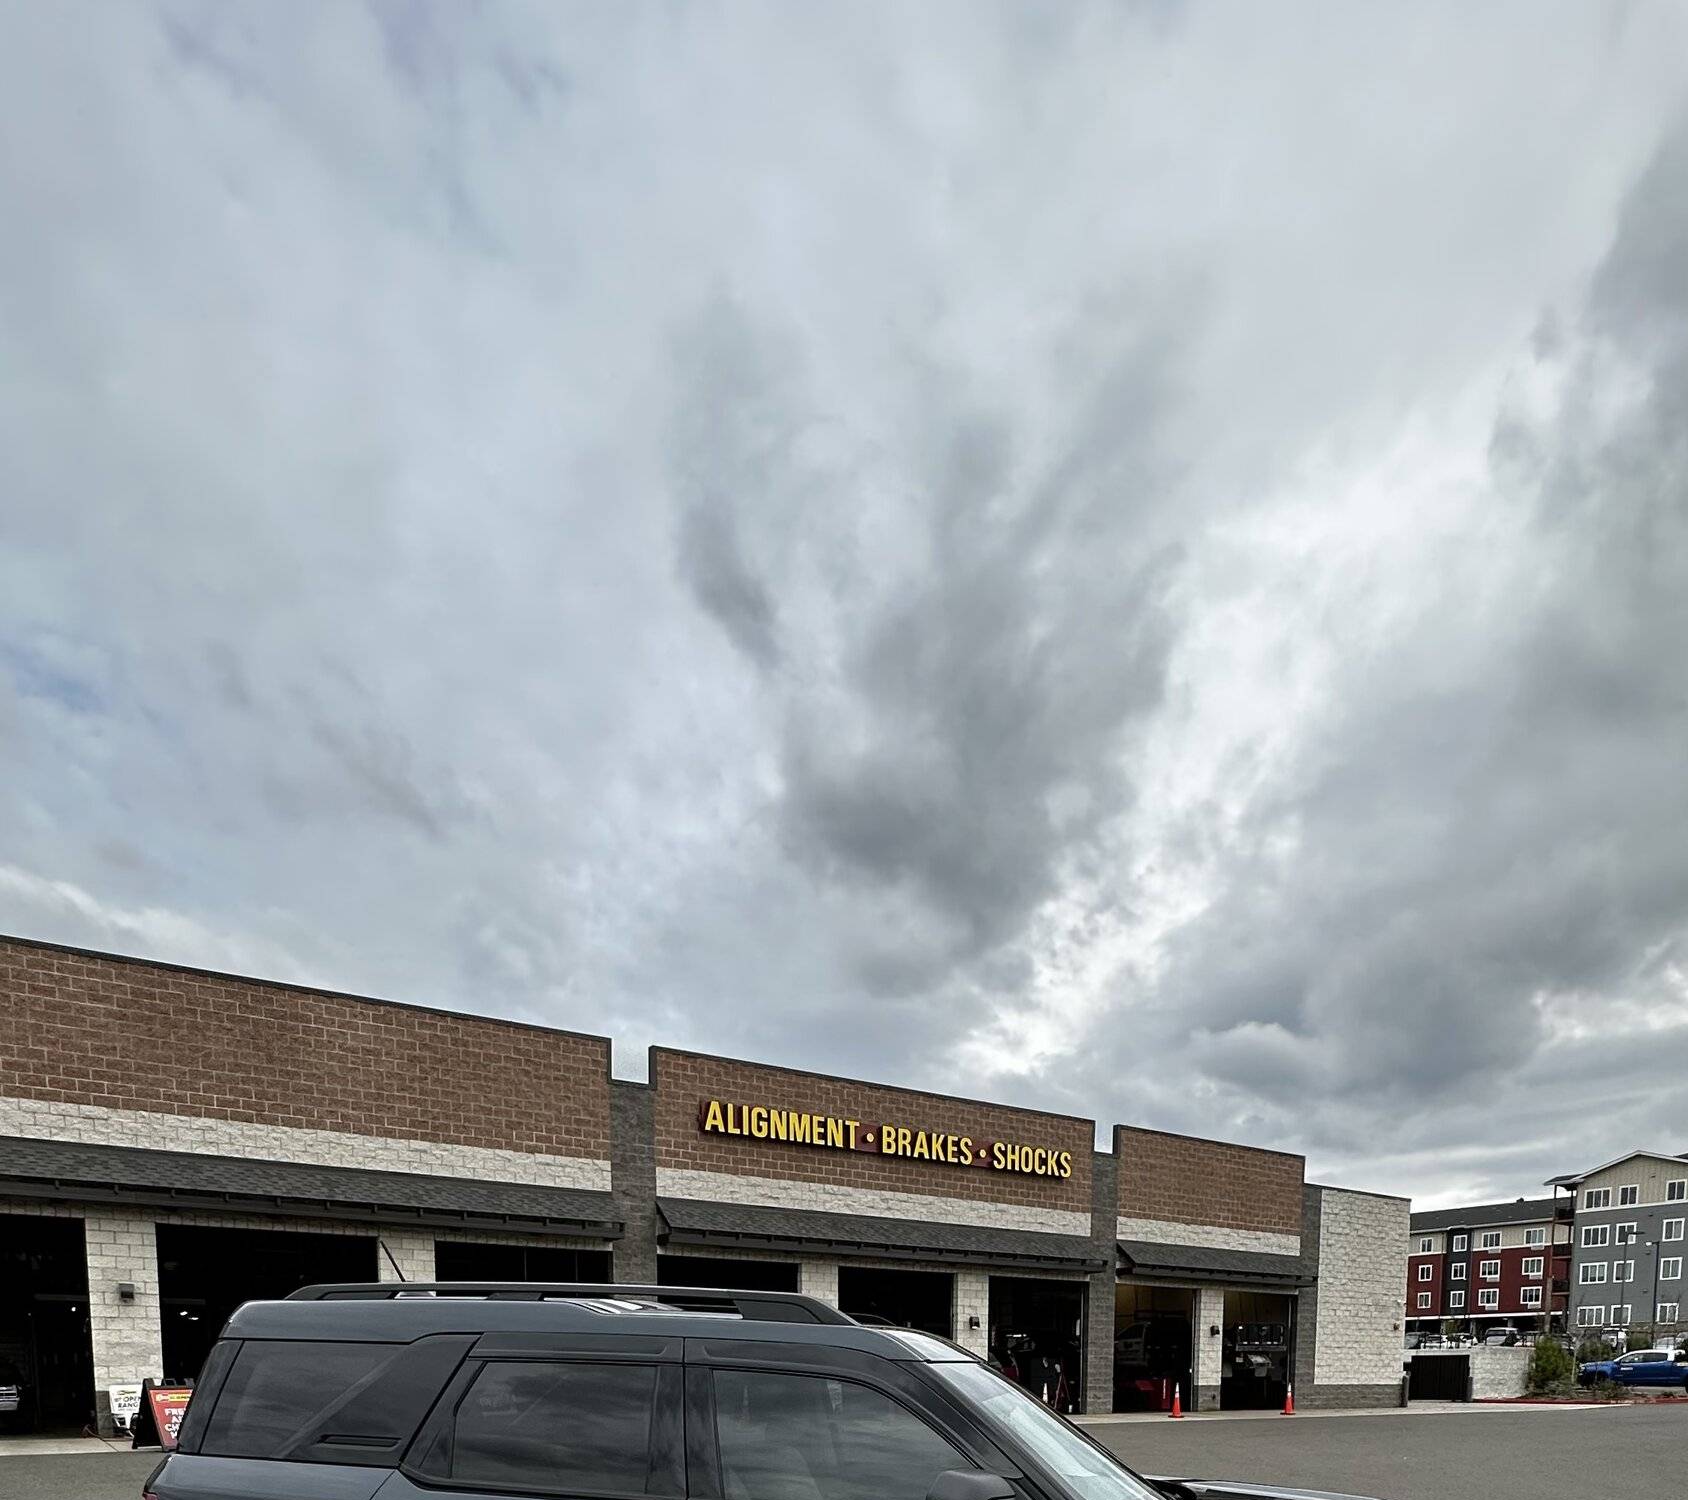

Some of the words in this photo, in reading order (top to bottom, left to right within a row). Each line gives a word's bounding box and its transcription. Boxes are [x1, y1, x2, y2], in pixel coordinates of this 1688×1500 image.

[704, 1100, 860, 1149] ALIGNMENT
[881, 1125, 973, 1166] BRAKES
[993, 1142, 1073, 1179] SHOCKS
